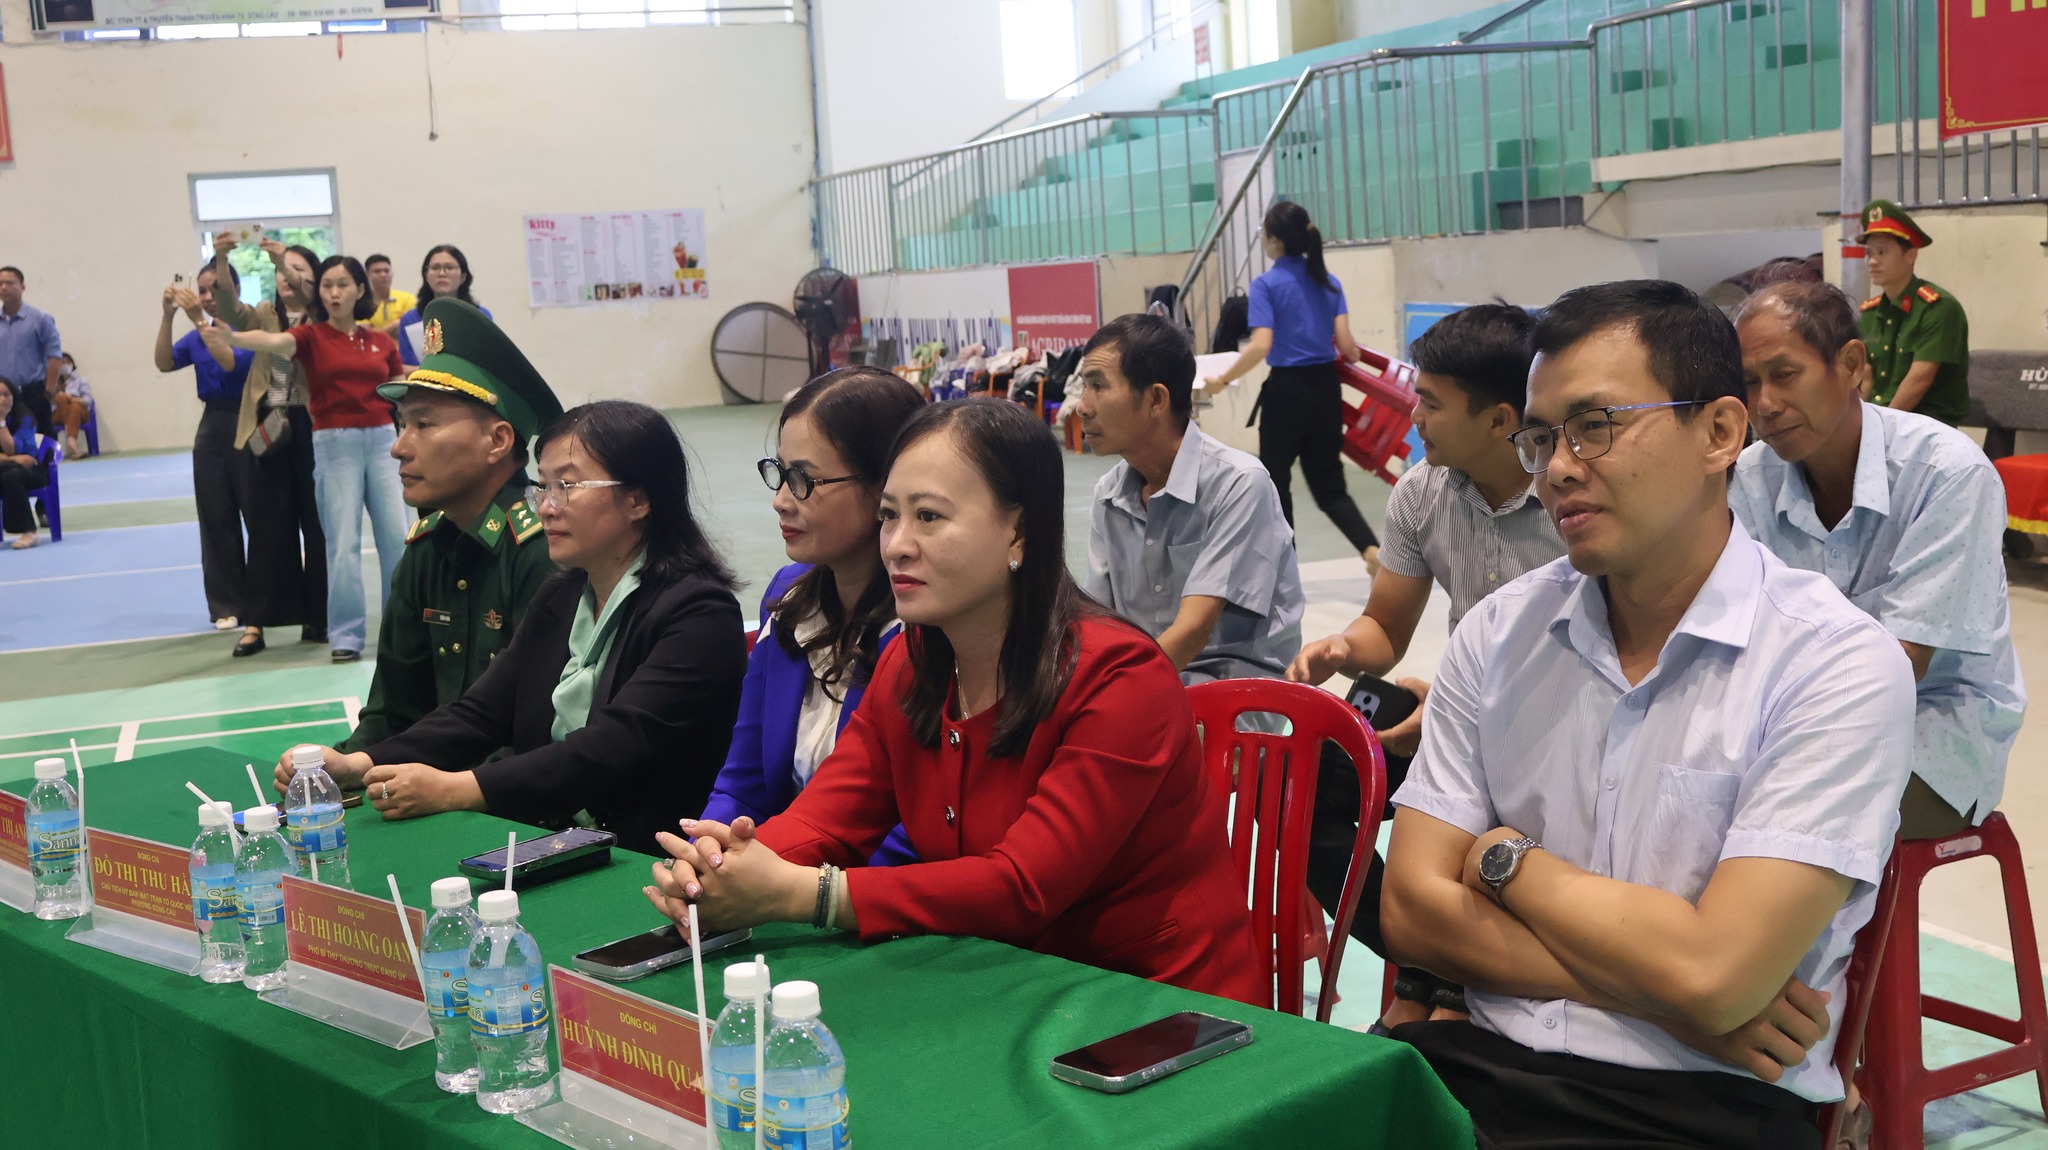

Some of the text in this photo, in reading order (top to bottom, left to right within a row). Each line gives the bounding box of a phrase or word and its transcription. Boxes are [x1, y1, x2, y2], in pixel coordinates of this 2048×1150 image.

[39, 832, 81, 851] Sann
[115, 861, 138, 888] THỊ
[140, 867, 168, 891] THU
[290, 906, 414, 965] LÊ THỊ HOÀNG OAN
[619, 1011, 658, 1035] ĐỒNG CHÍ
[561, 1015, 704, 1092] HUỲNH ĐÌNH QUA
